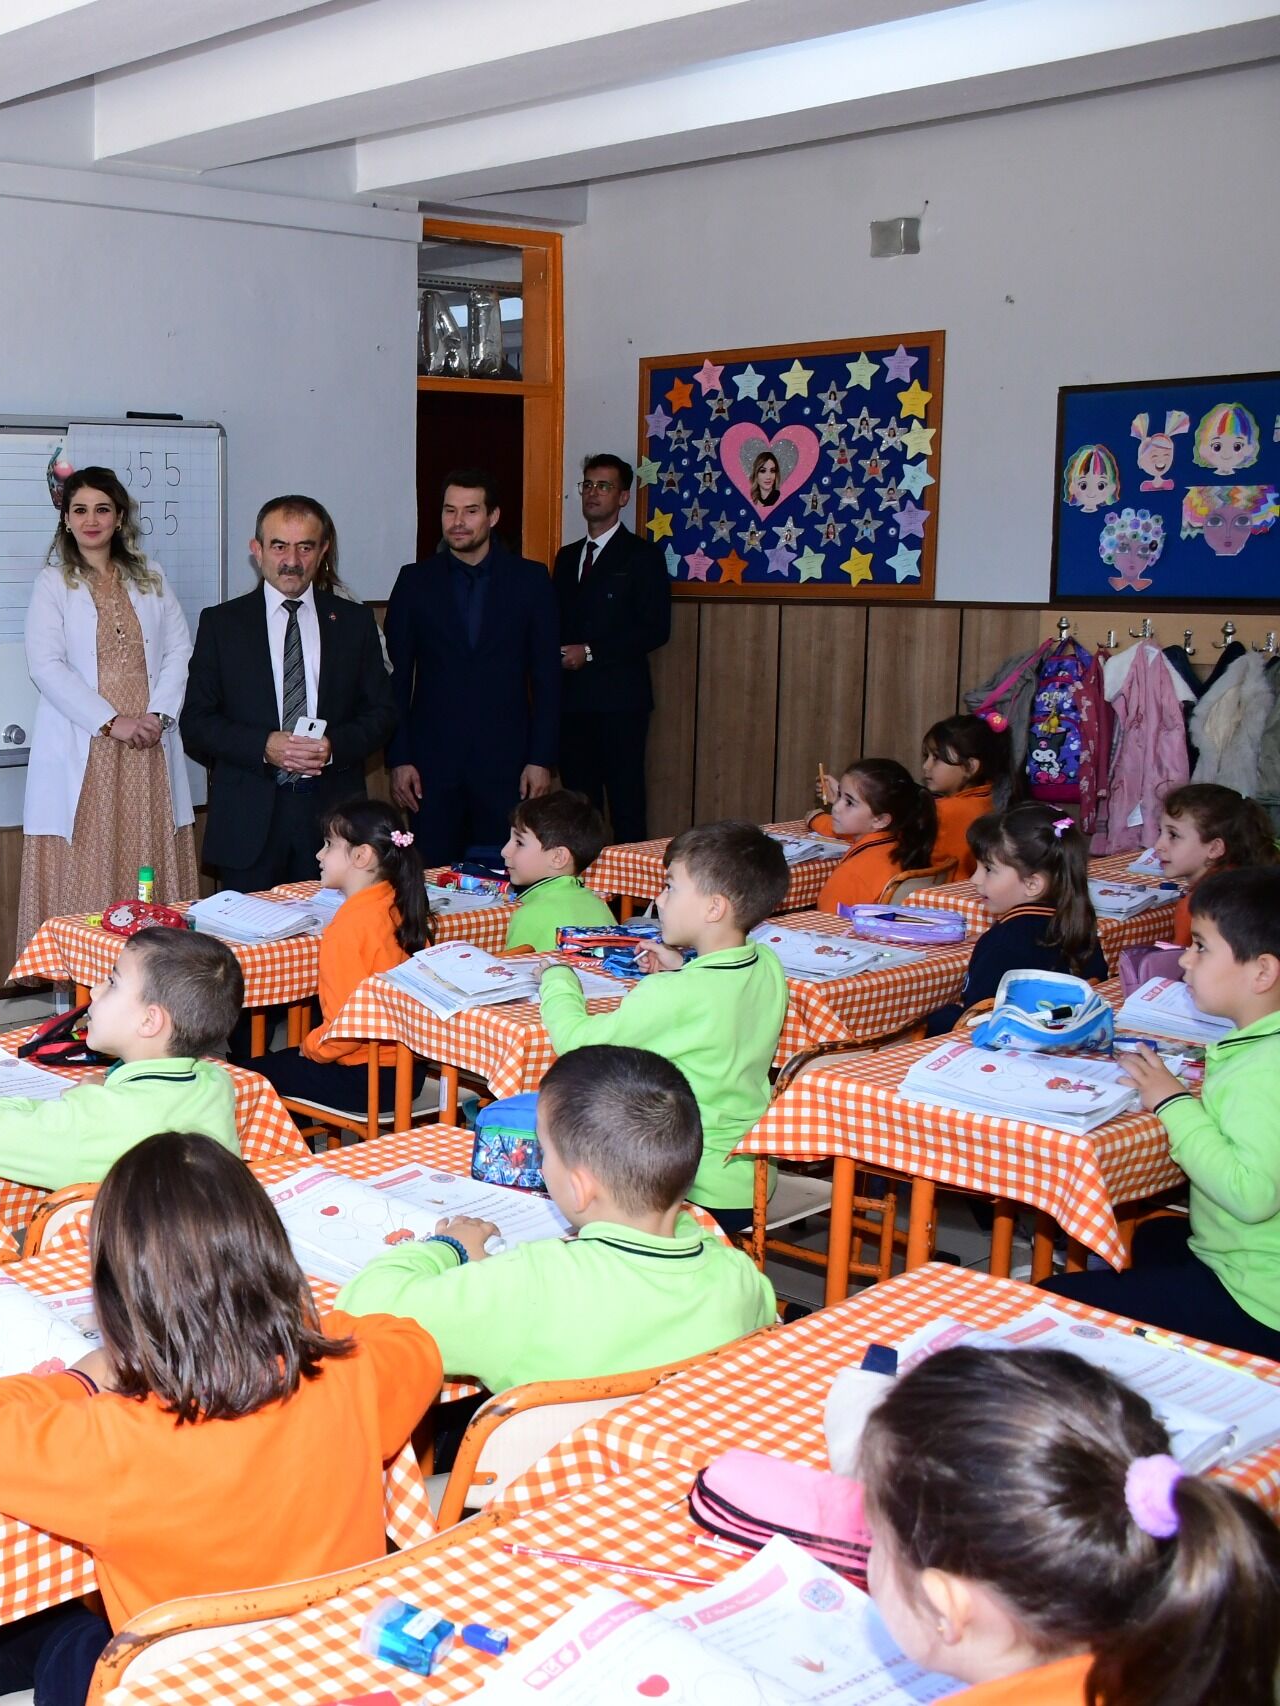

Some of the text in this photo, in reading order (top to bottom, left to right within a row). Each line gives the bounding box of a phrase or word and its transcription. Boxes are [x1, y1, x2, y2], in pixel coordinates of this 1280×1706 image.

[139, 451, 181, 488] 5 5
[164, 500, 180, 536] 5
